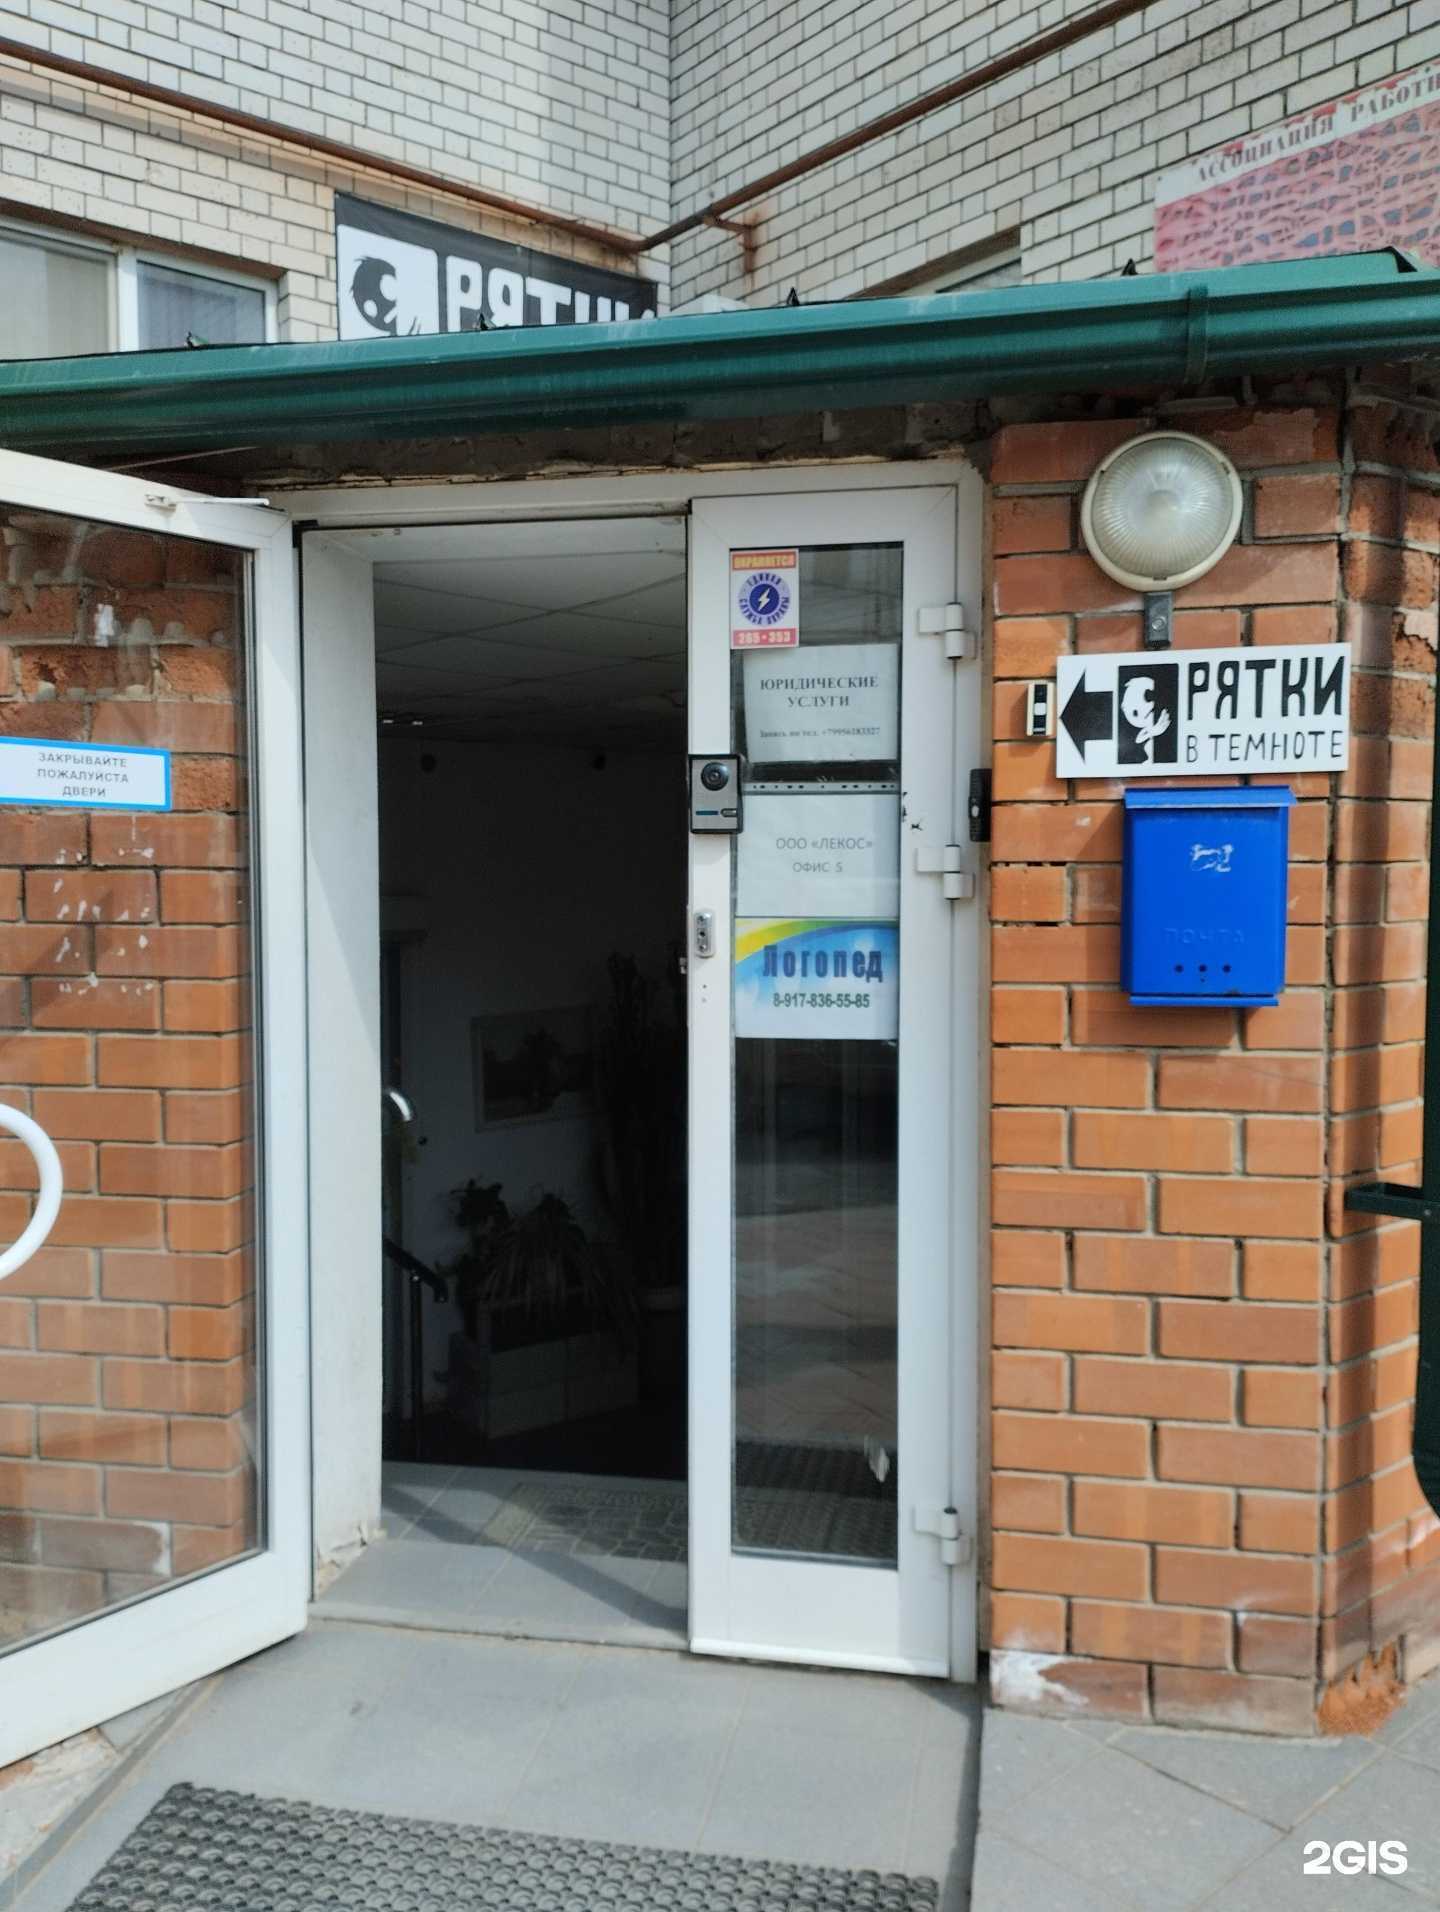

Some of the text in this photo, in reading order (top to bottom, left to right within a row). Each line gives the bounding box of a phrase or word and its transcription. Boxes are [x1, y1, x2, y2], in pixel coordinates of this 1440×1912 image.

[760, 676, 879, 691] ЮРИДИЧЕСКИЕ
[1187, 655, 1346, 721] РЯТКИ
[787, 695, 850, 708] УСЛУГИ
[1186, 730, 1345, 762] В ТЕМНОТЕ
[38, 752, 128, 768] ЗАКРЫВАЙТЕ
[62, 785, 107, 798] ДВЕРИ
[775, 836, 873, 850] ООО «ЛЕКОС»
[792, 862, 843, 873] ОФИС 5
[762, 944, 884, 983] Логопед
[772, 992, 871, 1009] 8-917-836-55-85
